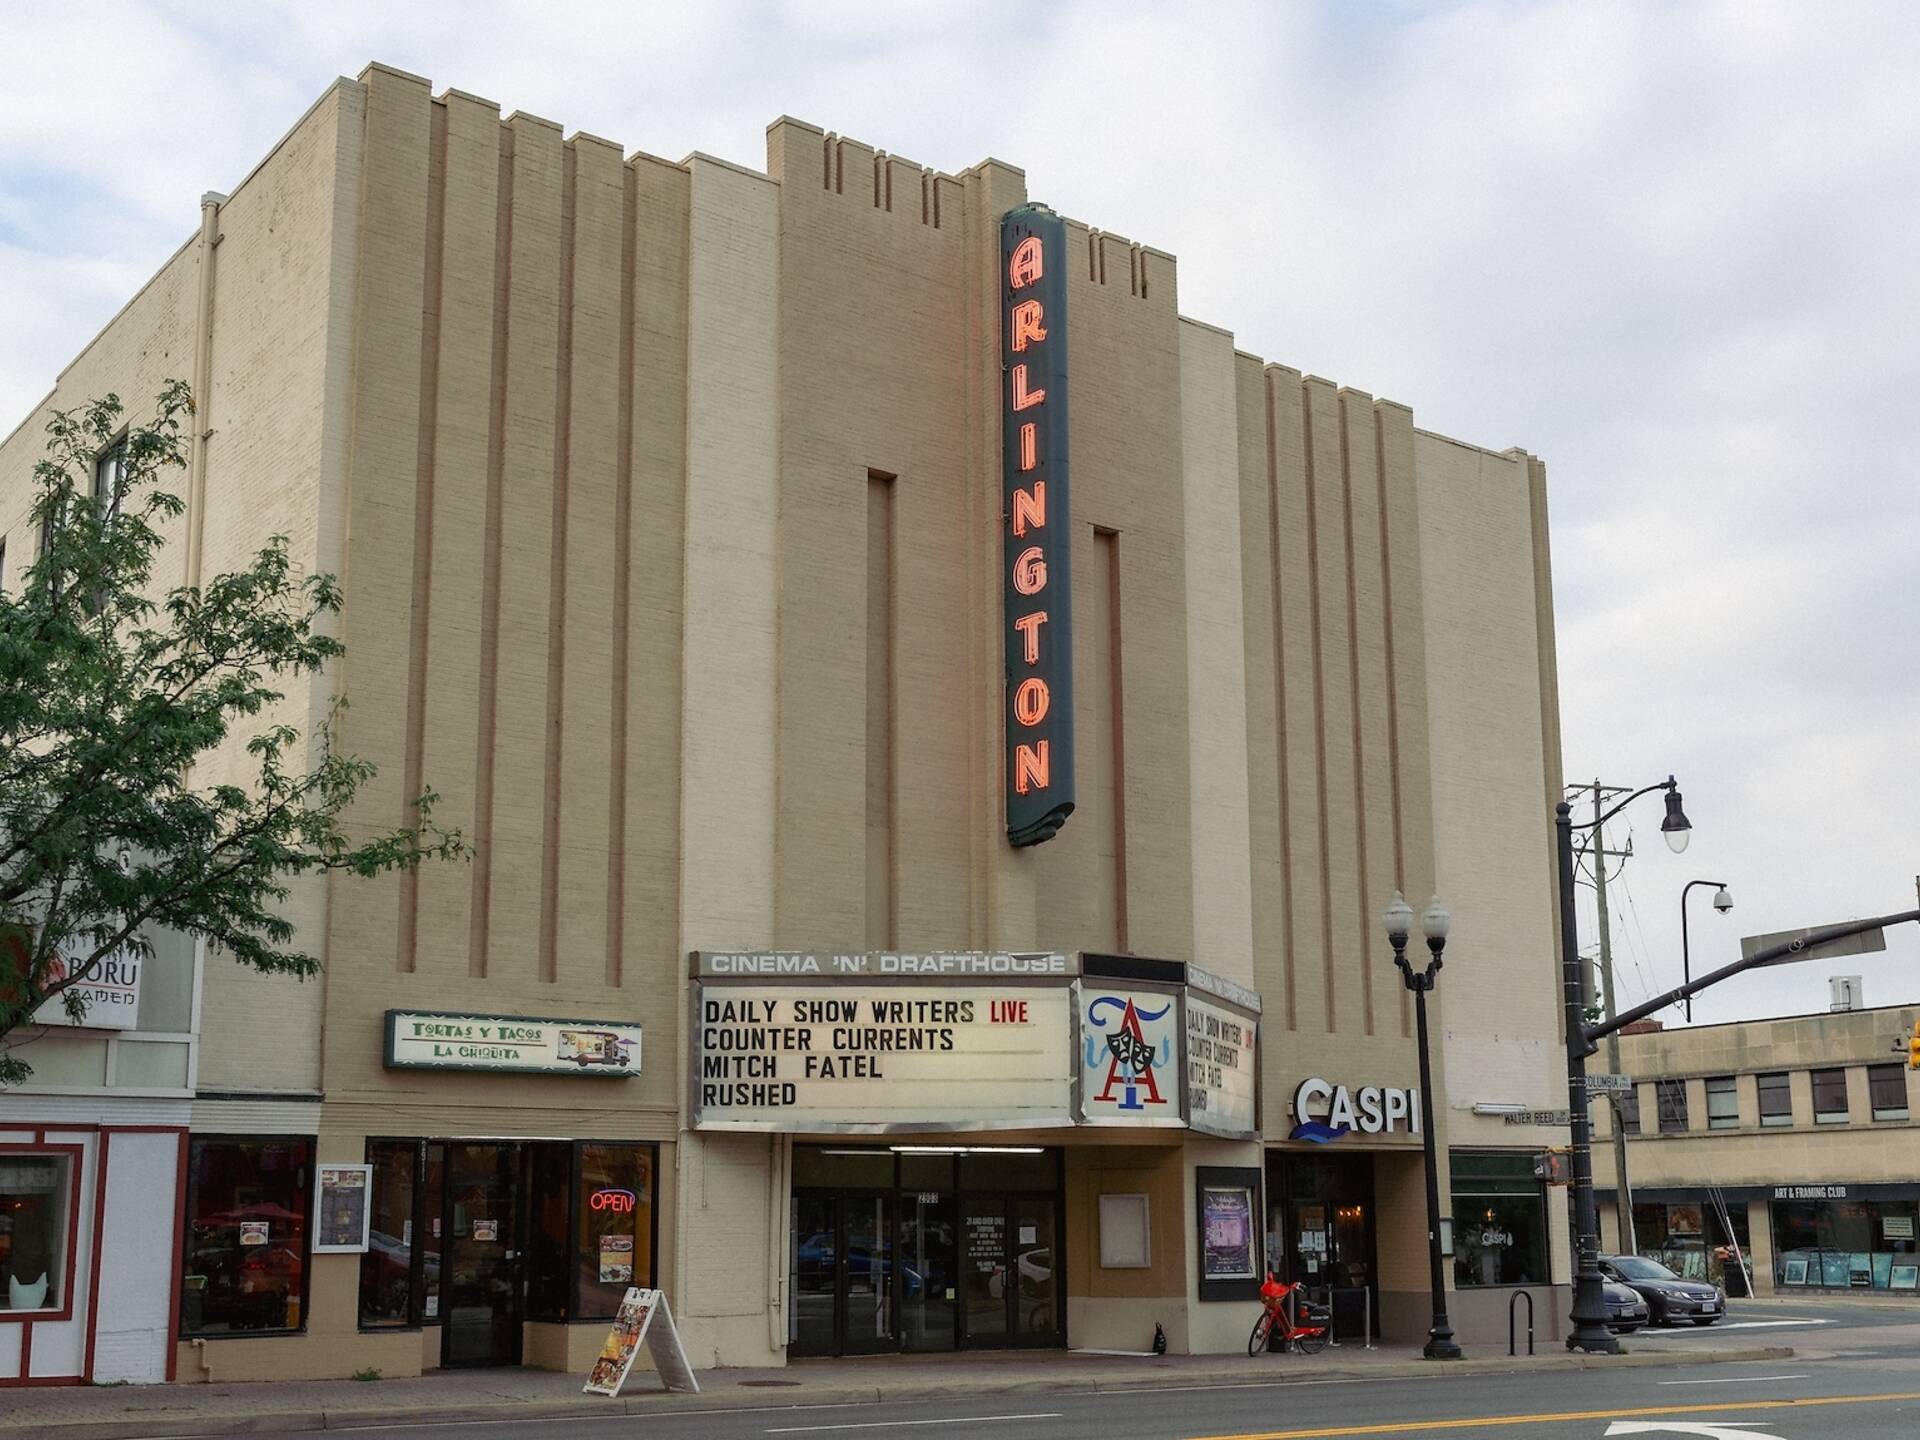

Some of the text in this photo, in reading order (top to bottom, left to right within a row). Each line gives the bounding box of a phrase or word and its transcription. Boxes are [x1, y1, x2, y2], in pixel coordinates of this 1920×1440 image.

[1008, 236, 1050, 796] ARLINGTON
[69, 957, 136, 986] BORU
[711, 955, 820, 972] CINEMA
[880, 955, 1065, 972] DRAFTHOUSE
[705, 1000, 1028, 1024] DAILY SHOW WRITERS LIVE
[412, 1023, 473, 1039] TORTAS
[498, 1026, 542, 1042] TACOS
[704, 1028, 953, 1051] COUNTER CURRENTS
[704, 1055, 883, 1079] MITCH FATEL
[703, 1082, 796, 1106] RUSHED
[1294, 1077, 1420, 1133] CASPI
[1504, 1111, 1531, 1125] WALTER
[1534, 1111, 1554, 1124] REED
[590, 1192, 632, 1212] OPEN
[1774, 1186, 1847, 1199] ART & FRAMING CLUB
